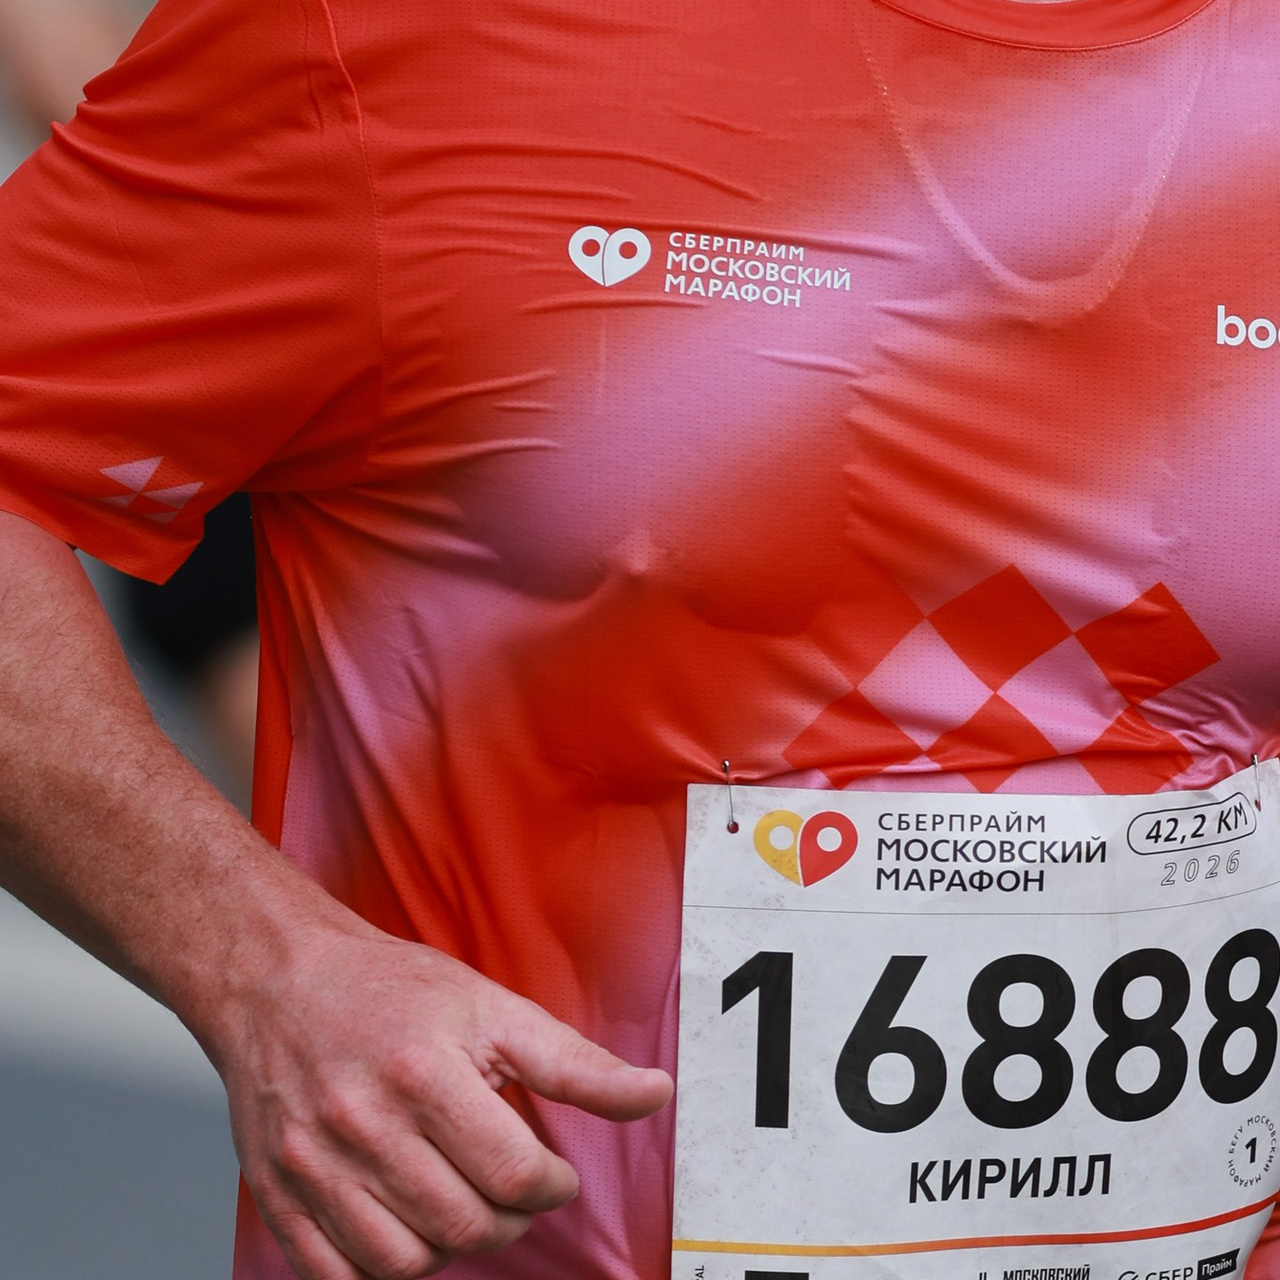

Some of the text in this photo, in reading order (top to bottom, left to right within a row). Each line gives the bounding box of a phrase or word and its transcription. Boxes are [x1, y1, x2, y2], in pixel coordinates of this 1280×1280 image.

[666, 251, 851, 291] МОСКОВСКИЙ
[664, 273, 801, 308] МАРАФОН
[877, 811, 1046, 833] СБЕРПРАЙМ
[1145, 814, 1206, 847] 42,2
[876, 836, 1107, 864] МОСКОВСКИЙ
[875, 868, 1045, 893] МАРАФОН
[1160, 850, 1241, 887] 2026
[1245, 1136, 1257, 1164] 1
[908, 1153, 1112, 1204] КИРИЛЛ
[1201, 1258, 1233, 1276] Прайм
